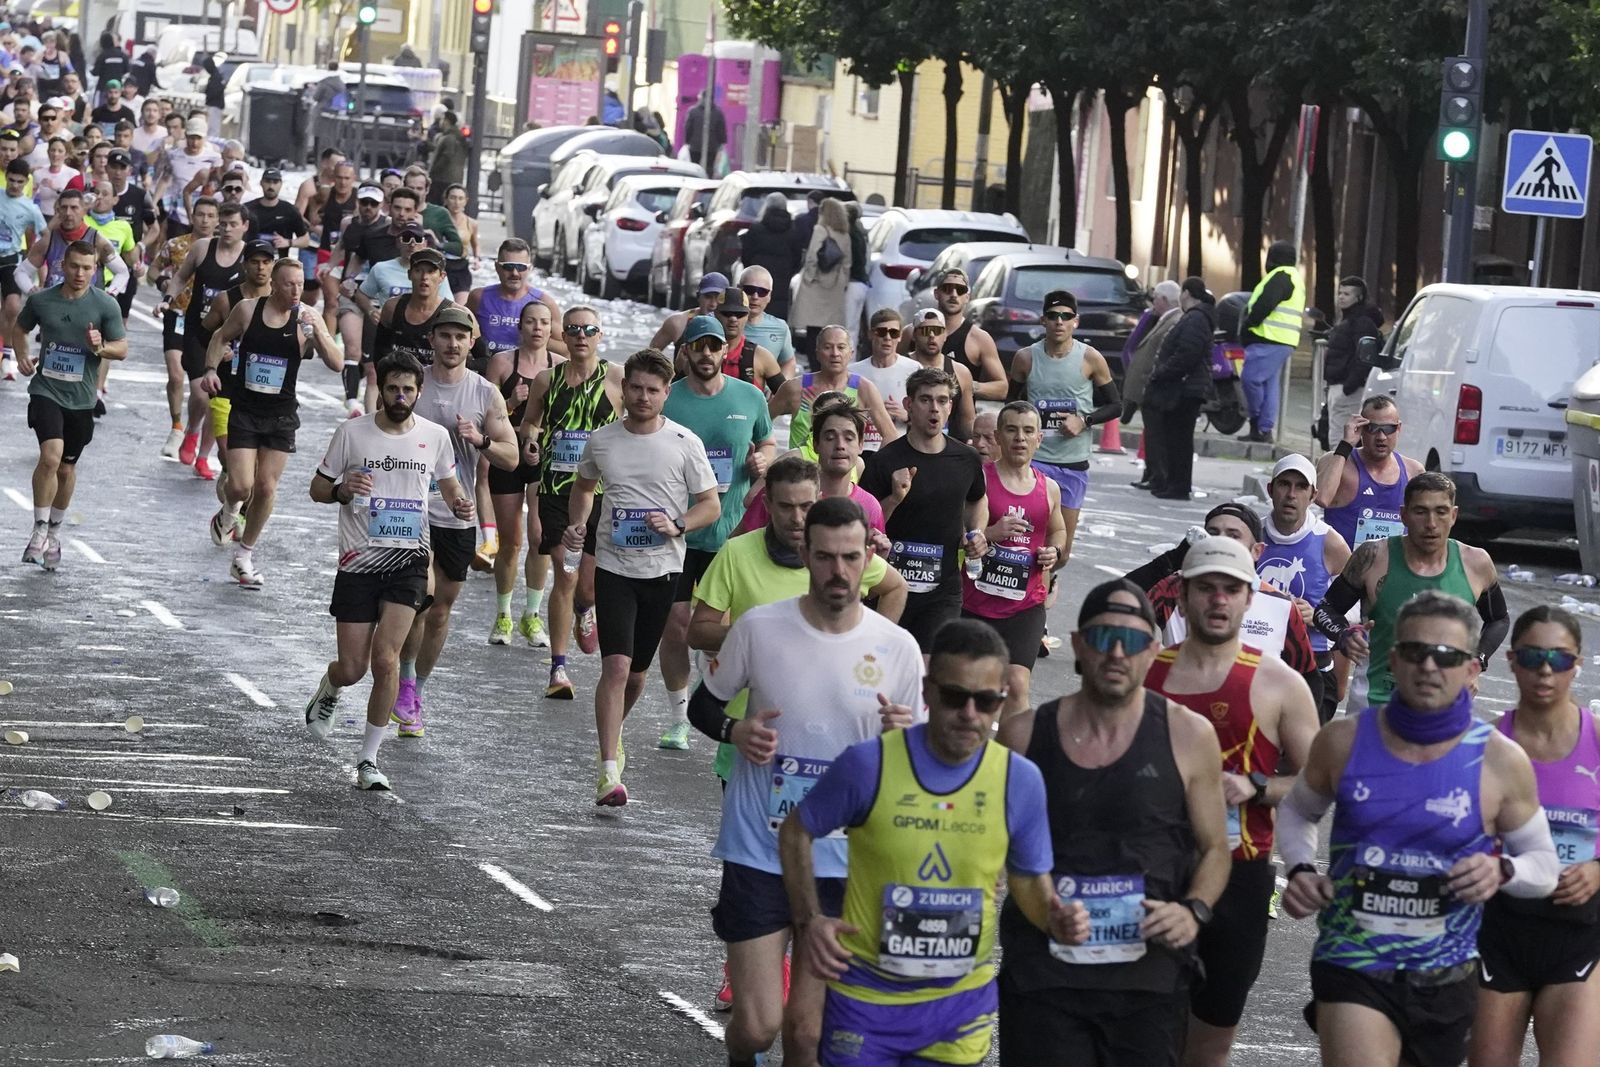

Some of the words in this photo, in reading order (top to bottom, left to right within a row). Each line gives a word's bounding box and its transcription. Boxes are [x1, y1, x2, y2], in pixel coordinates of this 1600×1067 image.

[58, 345, 82, 353] ZURICH
[52, 361, 74, 372] COLIN
[260, 357, 283, 365] ZURICH
[256, 375, 271, 384] COL
[1505, 440, 1539, 455] 9177
[1543, 444, 1568, 457] MFY
[389, 501, 419, 509] ZURICH
[389, 515, 406, 523] 7874
[378, 525, 413, 537] XAVIER
[625, 535, 653, 546] KOEN
[906, 545, 937, 555] ZURICH
[999, 550, 1028, 562] ZURICH
[906, 560, 923, 568] 4944
[899, 568, 935, 582] ARZAS
[985, 572, 1019, 588] MARIO
[1546, 810, 1588, 825] URICH
[893, 815, 939, 831] GPDM
[942, 819, 986, 834] Lecce
[1389, 853, 1443, 869] ZURICH
[1081, 880, 1134, 894] ZURICH
[919, 892, 972, 906] ZURICH
[1362, 892, 1440, 917] ENRIQUE
[1088, 923, 1140, 942] TINEZ
[888, 934, 973, 957] GAETANO
